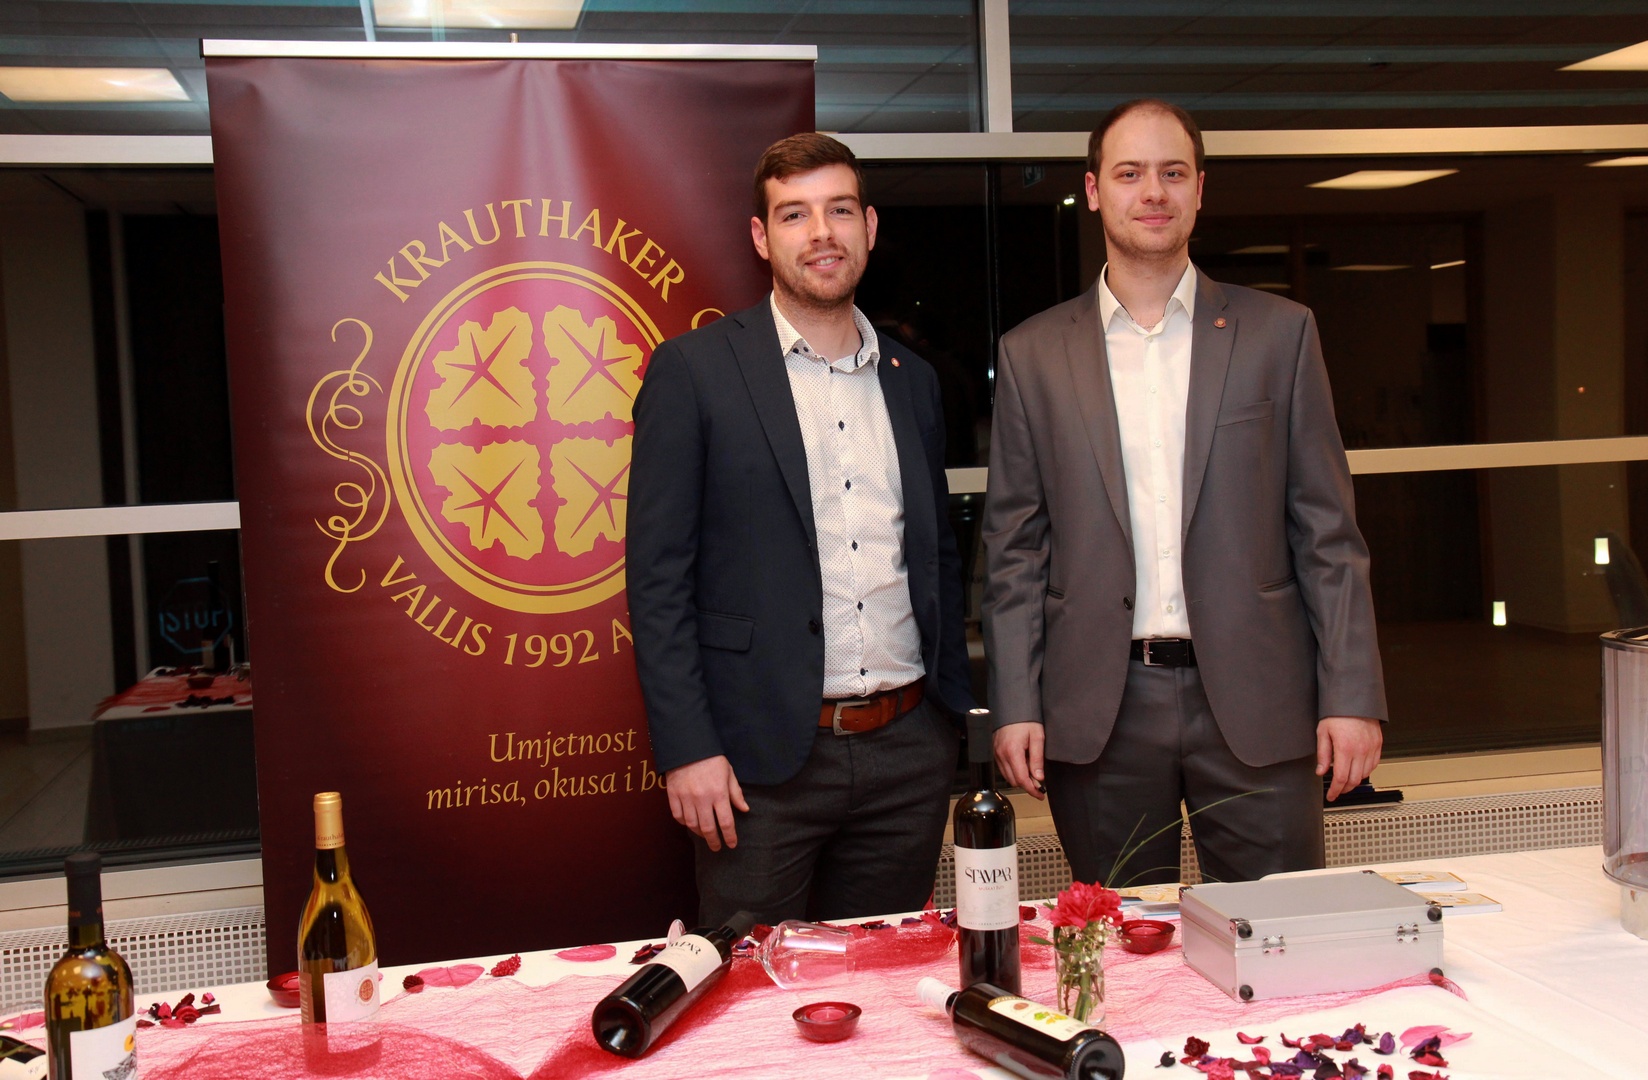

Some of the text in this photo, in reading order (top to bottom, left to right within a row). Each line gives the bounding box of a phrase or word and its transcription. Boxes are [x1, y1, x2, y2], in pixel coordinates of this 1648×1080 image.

[374, 198, 685, 303] KRAUTHAKER
[380, 555, 634, 668] VALLIS 1992 A
[488, 727, 637, 768] Umjetnost
[426, 779, 526, 810] mirisa,
[534, 767, 617, 800] okusa
[623, 769, 633, 792] i
[965, 867, 1011, 883] ŠTAMPAR
